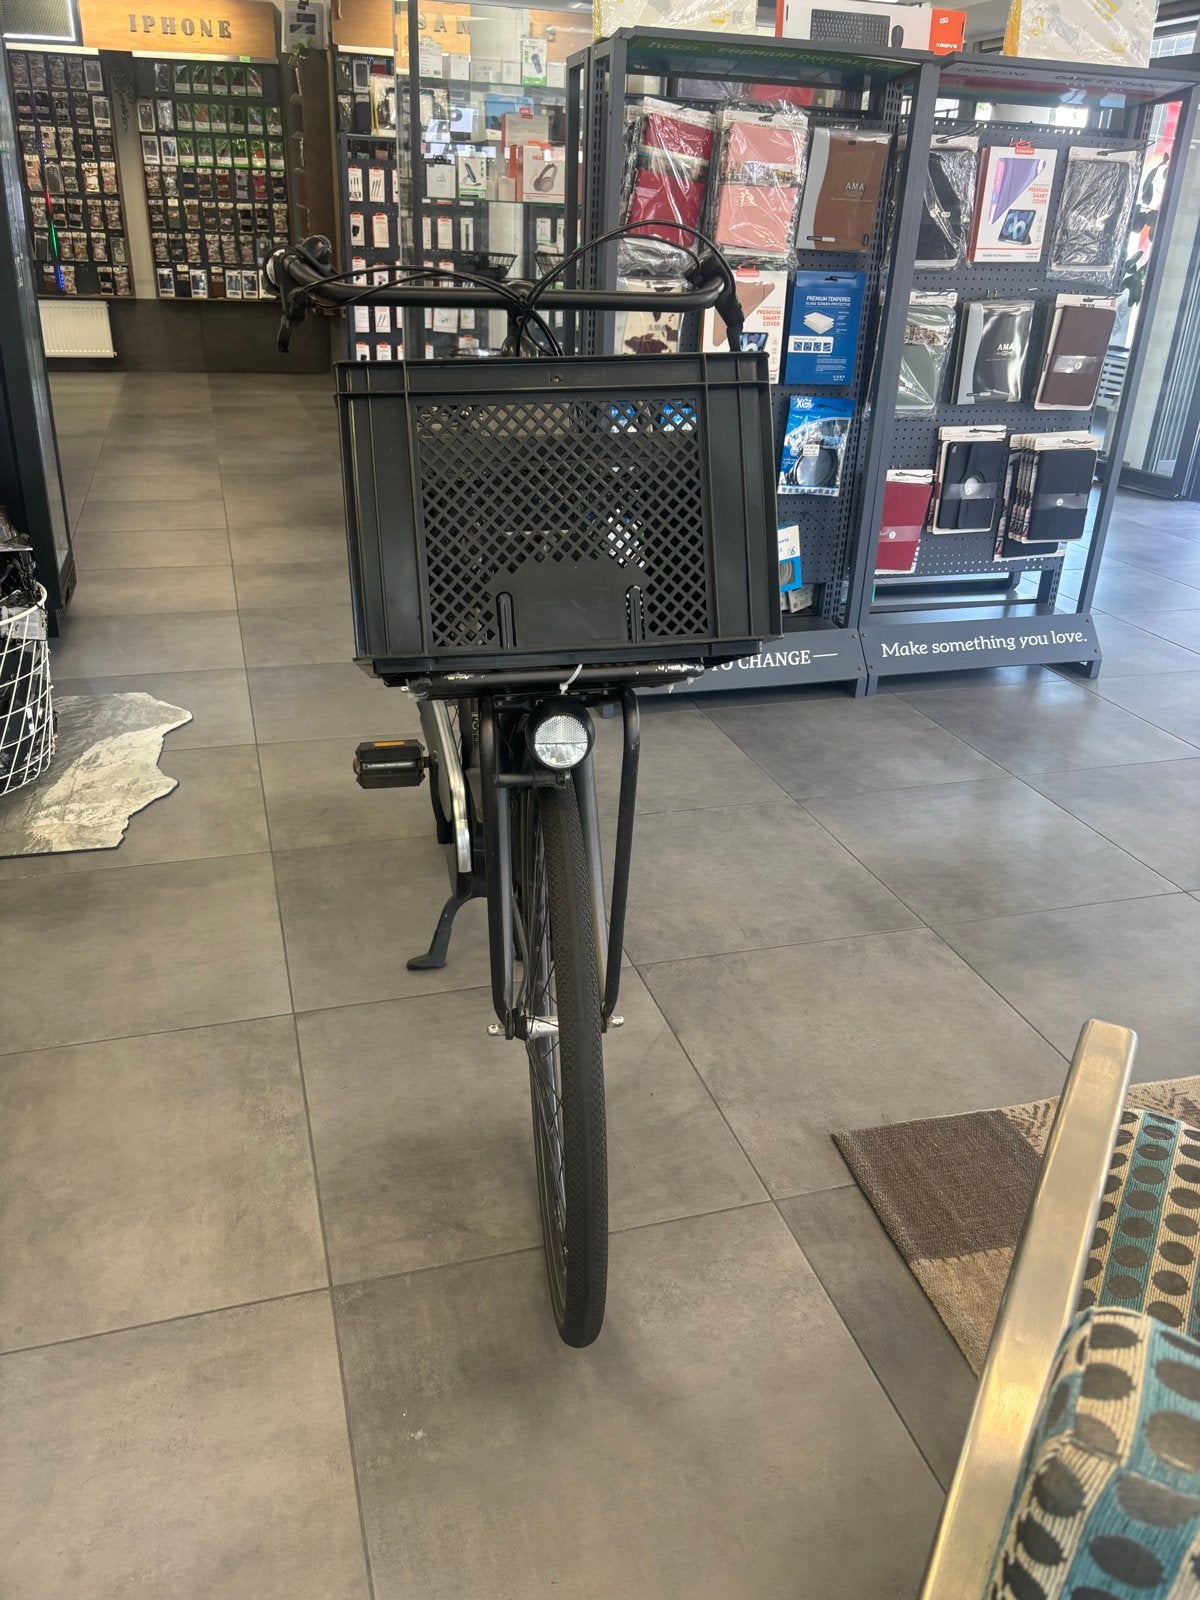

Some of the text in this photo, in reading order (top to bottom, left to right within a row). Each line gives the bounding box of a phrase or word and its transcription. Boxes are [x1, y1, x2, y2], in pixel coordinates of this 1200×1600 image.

[128, 14, 232, 39] IPHONE
[718, 47, 794, 58] PREMIUM
[845, 182, 865, 192] AMA
[997, 343, 1014, 351] AMA
[881, 630, 1088, 658] Make something you love.
[737, 650, 811, 670] CHANGE
